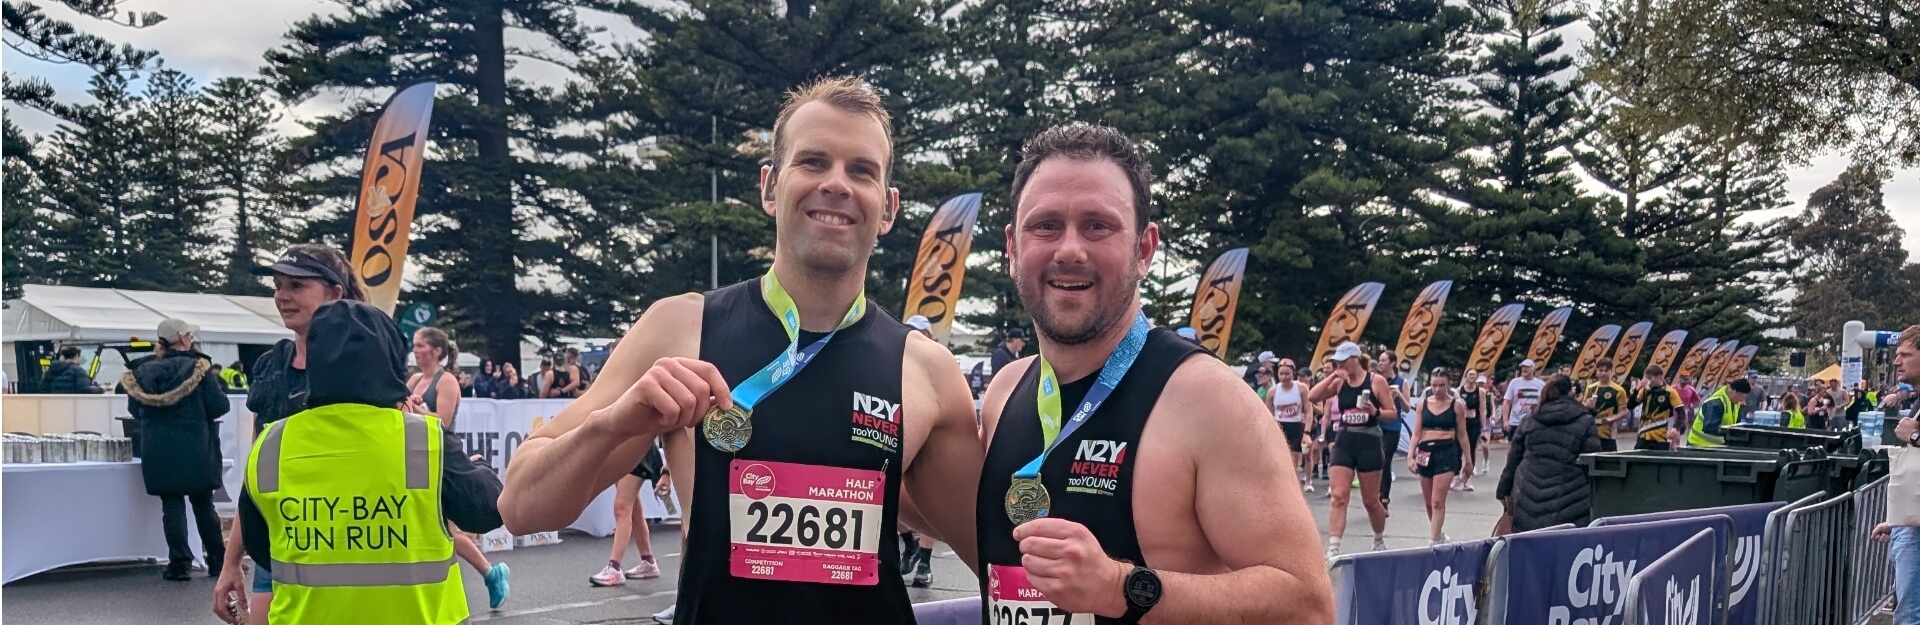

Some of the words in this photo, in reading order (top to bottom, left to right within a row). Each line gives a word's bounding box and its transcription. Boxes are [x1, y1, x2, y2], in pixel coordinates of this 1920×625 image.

[854, 391, 900, 422] N2Y
[852, 411, 898, 437] NEVER
[1075, 440, 1127, 463] N2Y
[1070, 462, 1119, 478] NEVER
[808, 487, 874, 500] MARATHON
[846, 478, 875, 490] HALF
[279, 495, 407, 522] CITY-BAY
[746, 501, 864, 550] 22681
[285, 526, 334, 551] FUN
[347, 524, 408, 550] RUN
[745, 558, 783, 566] COMPETITION
[752, 565, 774, 575] 22681
[831, 570, 853, 580] 22681
[1567, 544, 1637, 615] City
